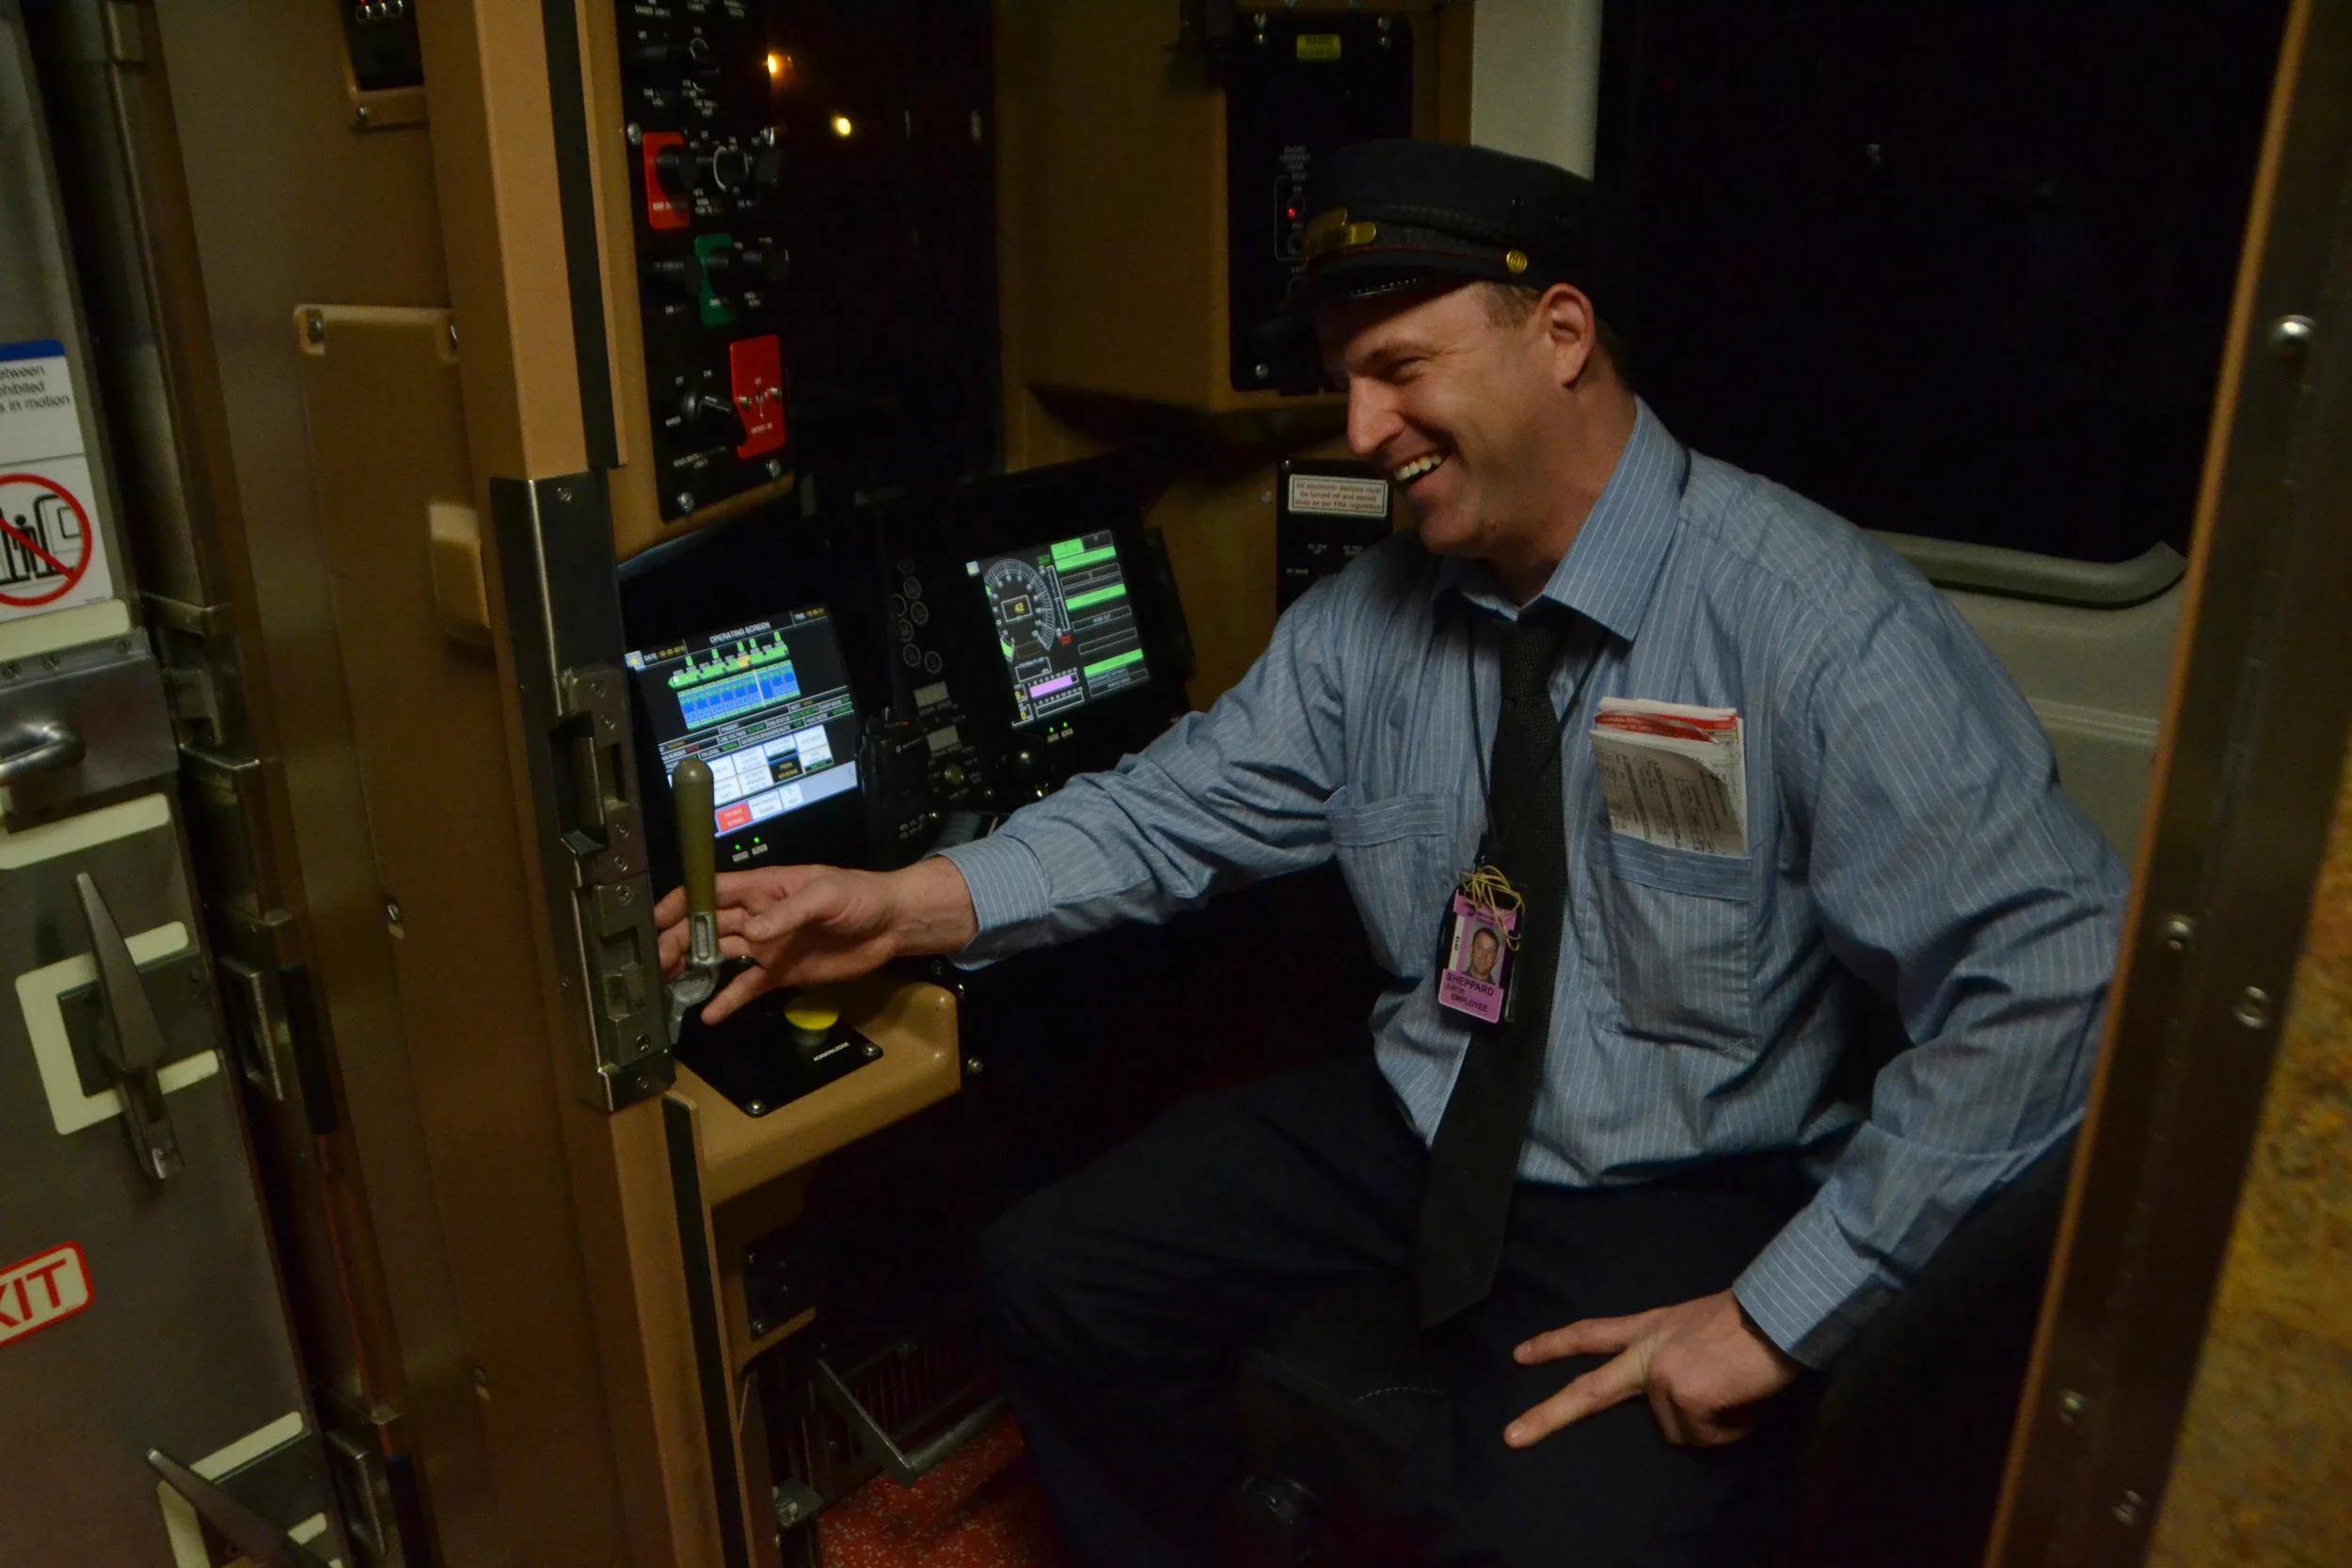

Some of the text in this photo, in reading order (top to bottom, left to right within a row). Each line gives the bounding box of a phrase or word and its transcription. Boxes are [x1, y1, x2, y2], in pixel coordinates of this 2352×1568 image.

[8, 398, 22, 411] in
[24, 395, 70, 411] motion
[1014, 602, 1025, 612] 42
[709, 621, 771, 644] OPERATING SCREEN
[1447, 972, 1495, 997] SHEPPARD
[1451, 993, 1488, 1013] EMPLOYEE
